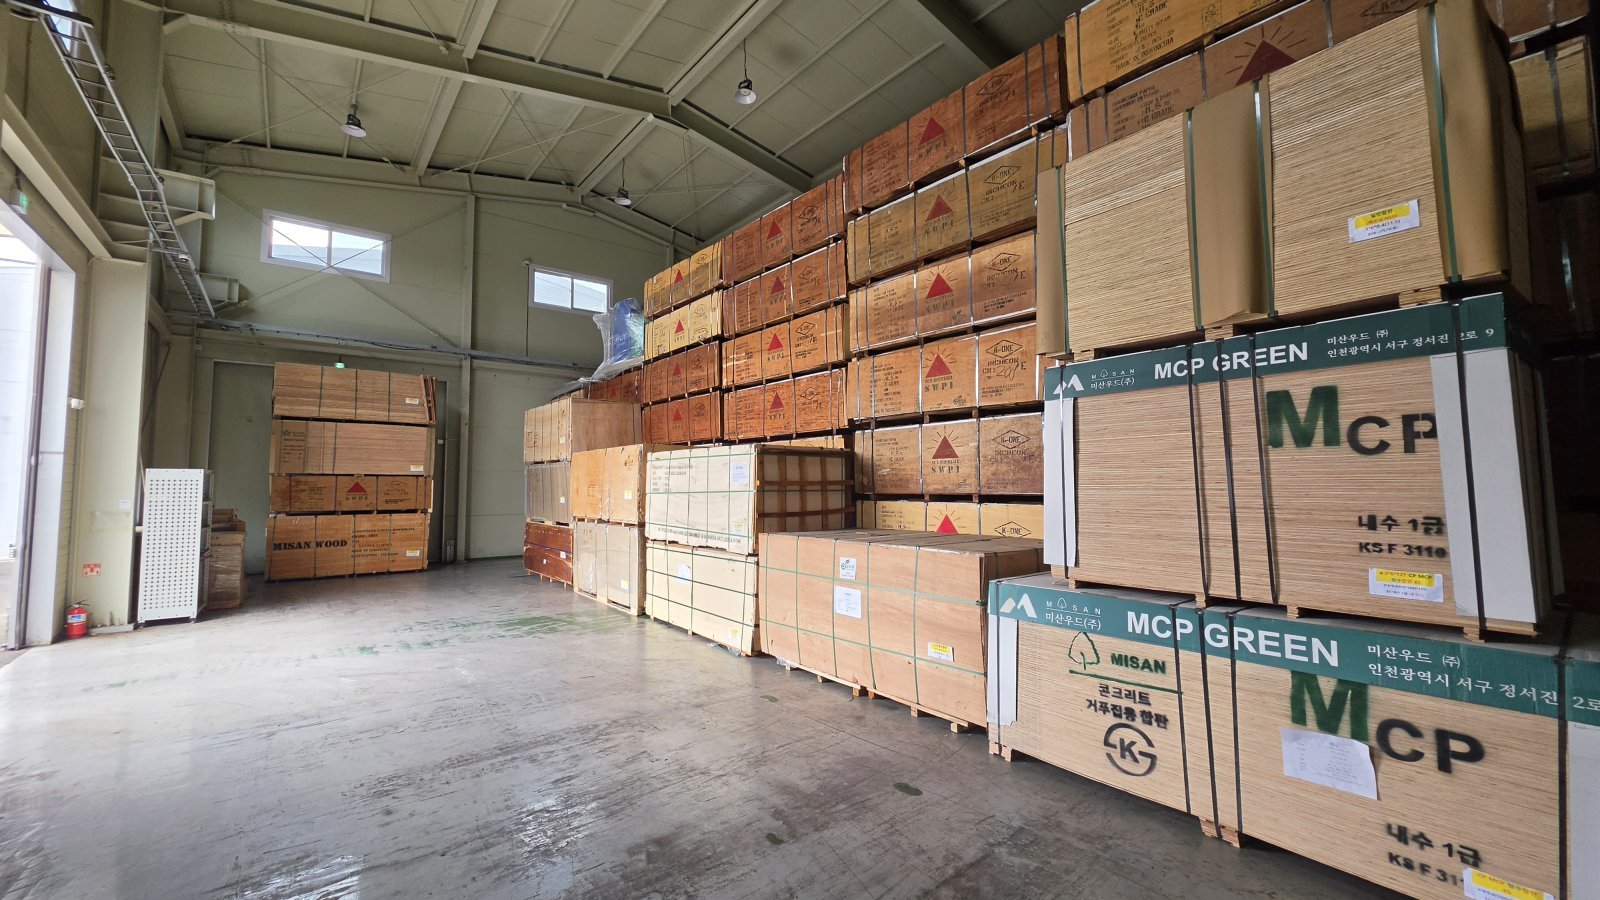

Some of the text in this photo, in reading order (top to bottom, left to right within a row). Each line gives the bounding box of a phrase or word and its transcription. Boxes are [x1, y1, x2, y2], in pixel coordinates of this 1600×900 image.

[1327, 331, 1371, 346] 미산우드
[1327, 343, 1381, 359] 인천광역시
[1385, 340, 1409, 351] 서구
[1412, 333, 1449, 347] 정서진
[1485, 328, 1494, 337] 9
[1154, 341, 1308, 380] MCP GREEN
[1090, 376, 1135, 390] 미산우드(주)
[1266, 385, 1437, 456] MCP
[931, 466, 960, 474] SWPI
[1358, 514, 1400, 531] 내수
[272, 539, 347, 551] MISAN WOOD
[1045, 611, 1101, 631] 미산우드(주)
[1127, 610, 1339, 667] MCP GREEN
[1111, 652, 1166, 674] MISAN
[1368, 644, 1432, 663] 미산우드
[1098, 683, 1152, 706] 콘크리트
[1368, 663, 1449, 687] 인천광역시
[1457, 677, 1493, 694] 서구
[1499, 684, 1559, 706] 정서진
[1086, 698, 1169, 730] 거푸집용 합판
[1386, 823, 1434, 851] 내수
